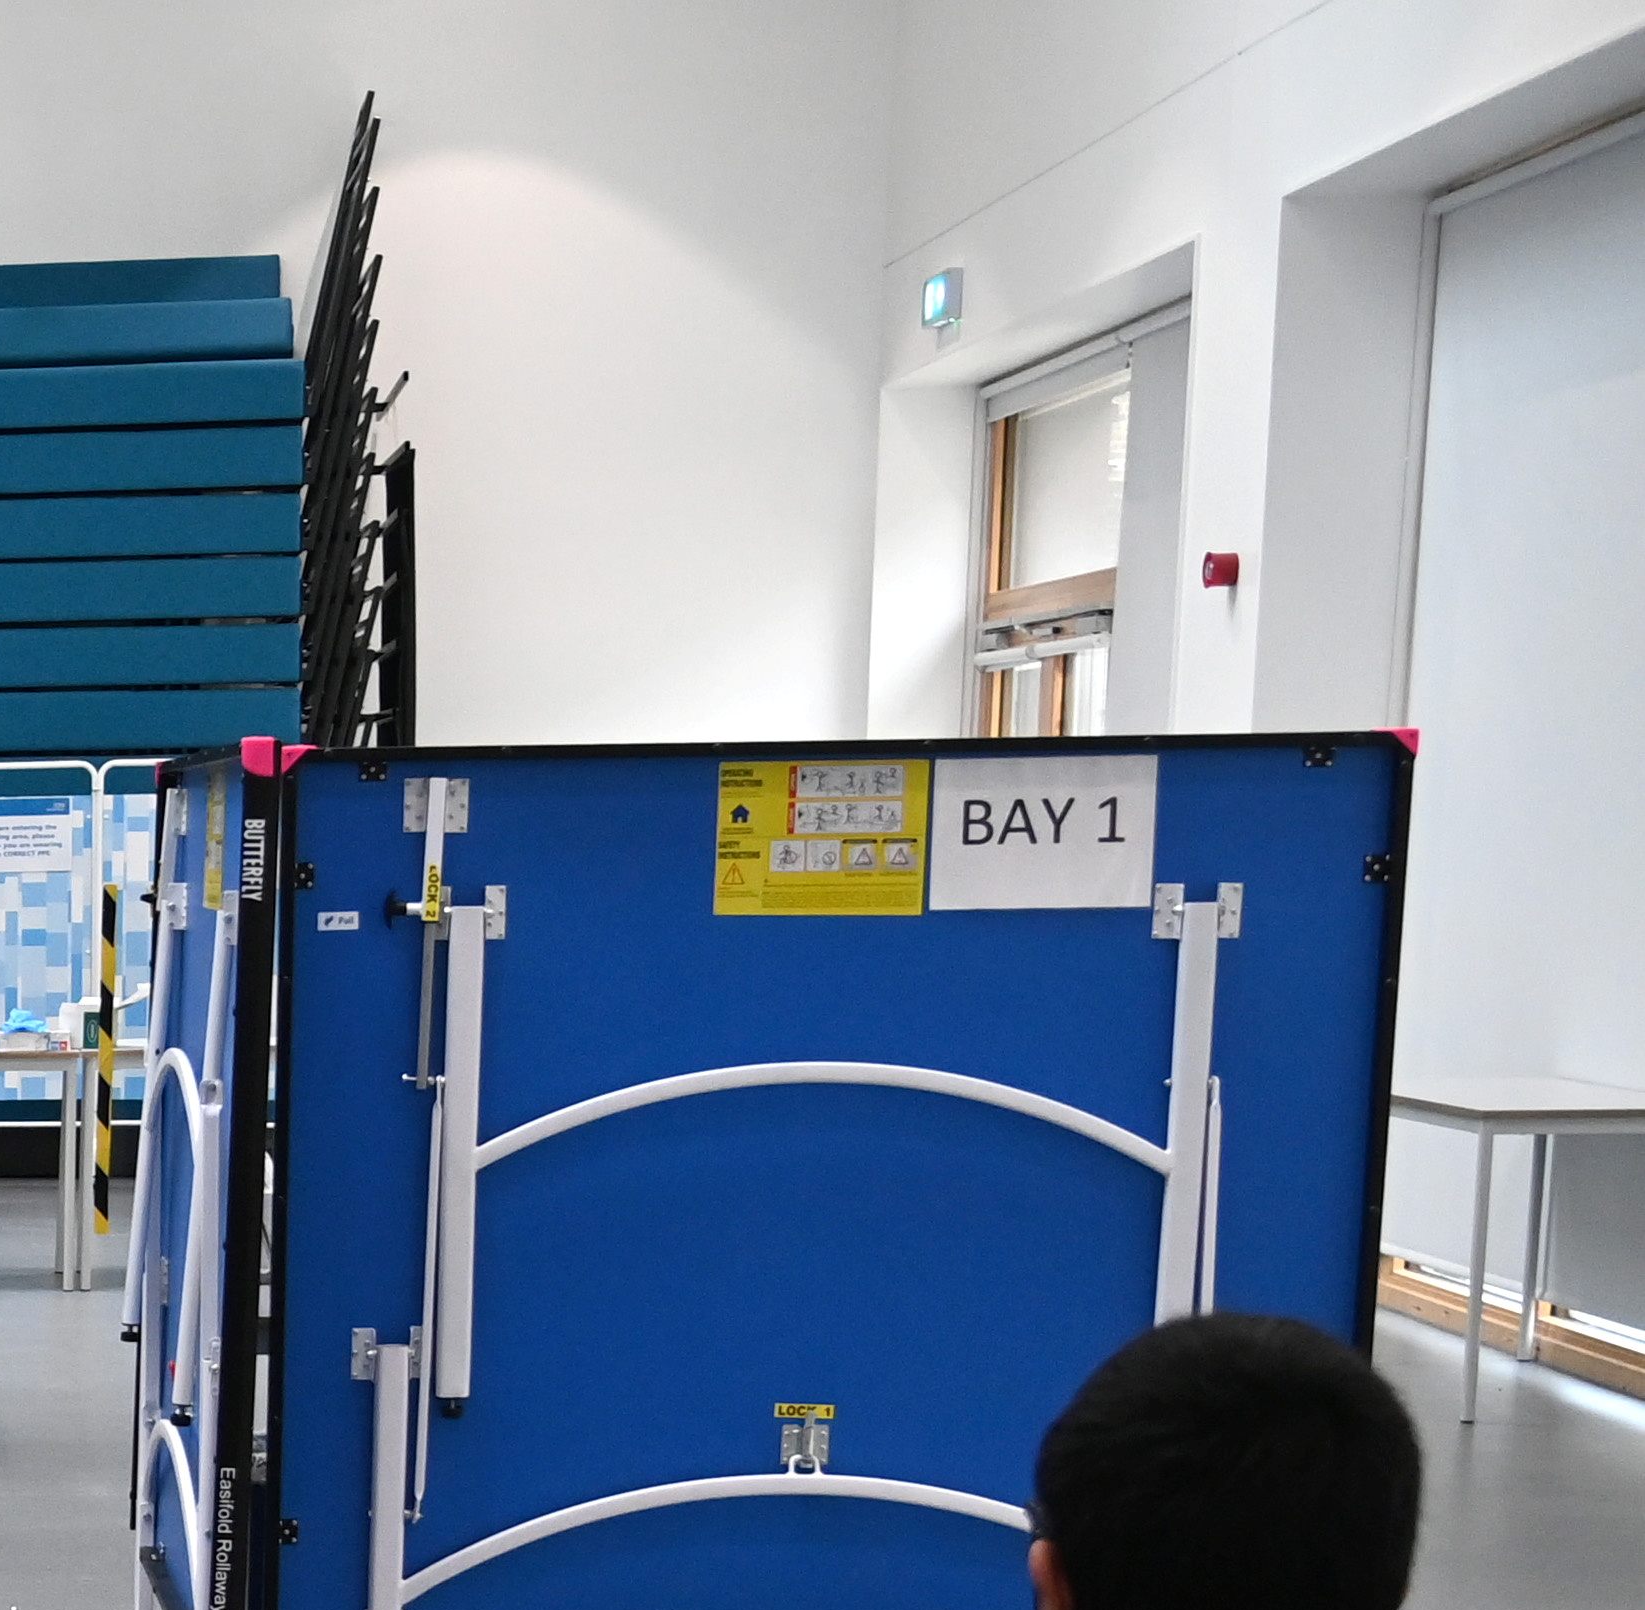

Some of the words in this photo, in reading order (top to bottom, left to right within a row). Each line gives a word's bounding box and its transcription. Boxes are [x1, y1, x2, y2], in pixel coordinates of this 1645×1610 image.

[962, 797, 1075, 845] BAY
[1097, 796, 1125, 843] 1
[241, 819, 266, 901] BUTTERFLY
[338, 916, 354, 925] Pull
[425, 910, 436, 918] 2
[824, 1406, 831, 1417] 1
[217, 1467, 236, 1534] Easifold
